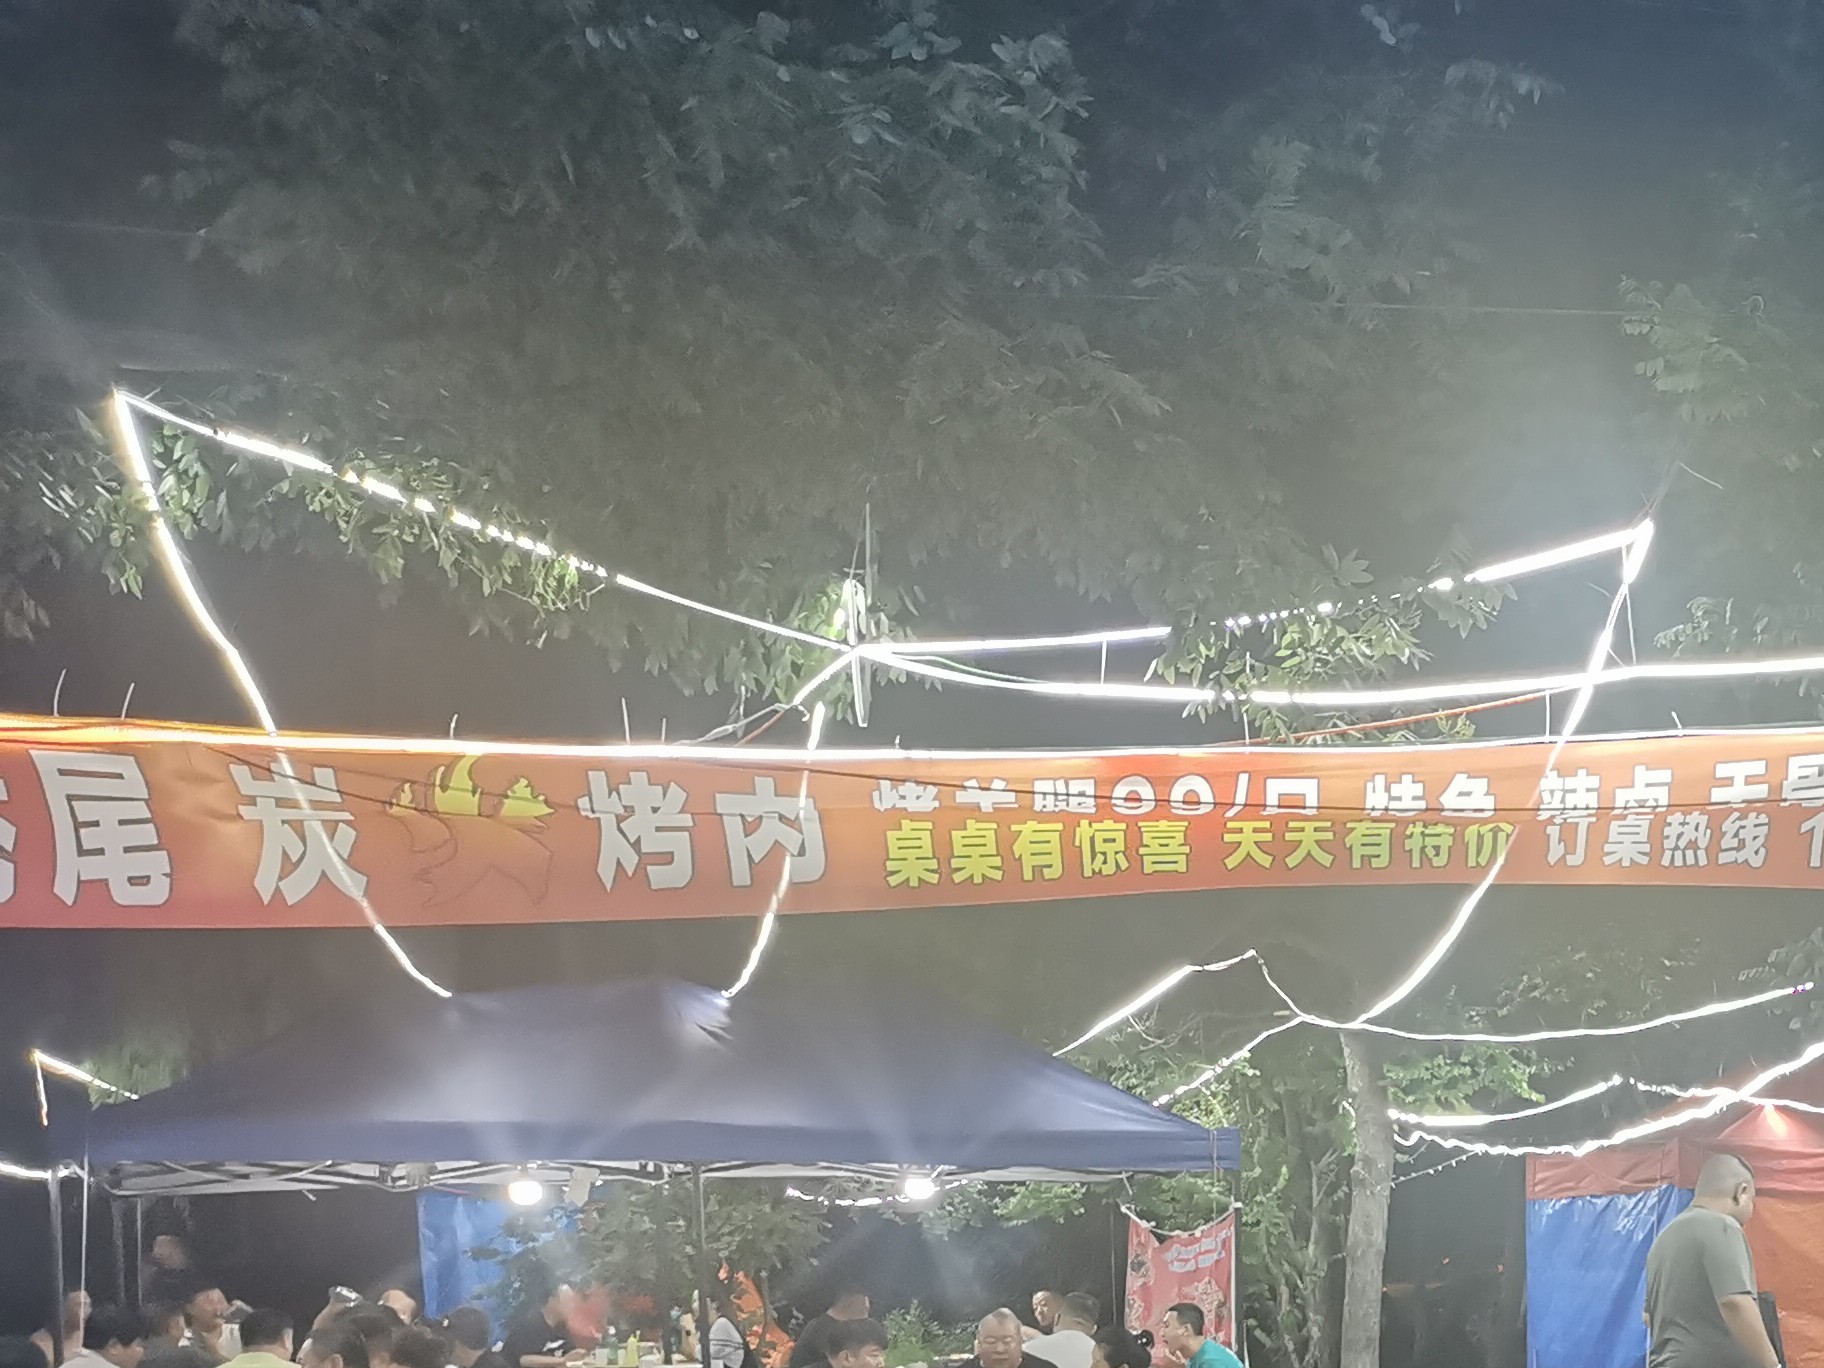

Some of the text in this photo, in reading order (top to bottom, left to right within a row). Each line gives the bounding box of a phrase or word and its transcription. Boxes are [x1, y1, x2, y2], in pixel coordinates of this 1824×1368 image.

[0, 748, 827, 907] 尾 炭 烤肉
[884, 818, 1193, 888] 桌桌有惊喜
[1222, 818, 1515, 871] 天天有特价
[1545, 811, 1770, 868] 订桌热线
